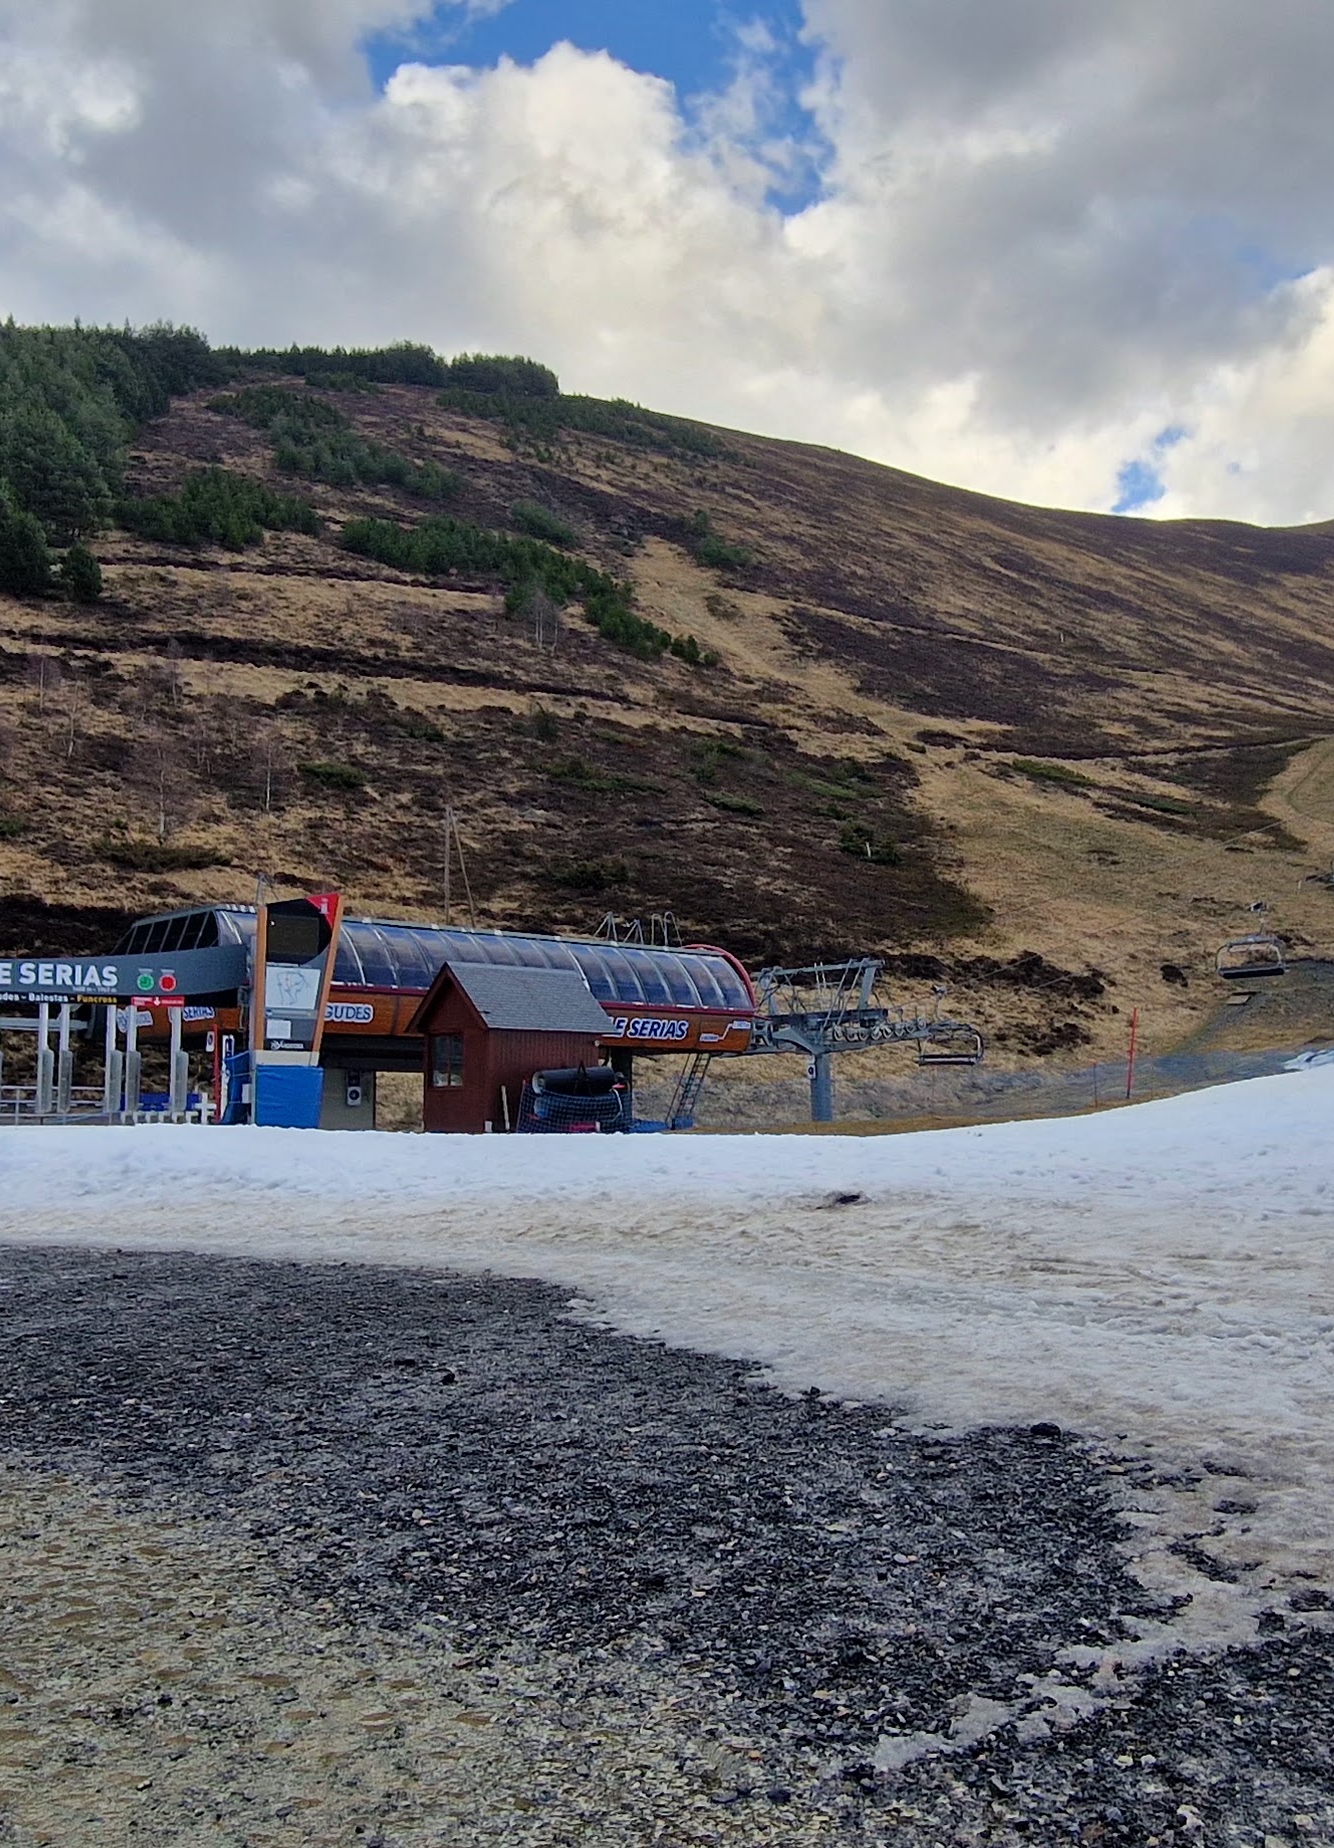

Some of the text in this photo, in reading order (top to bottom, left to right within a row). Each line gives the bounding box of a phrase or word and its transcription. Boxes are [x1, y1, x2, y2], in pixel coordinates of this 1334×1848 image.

[19, 962, 118, 987] SERIAS
[324, 1004, 372, 1020] GUDES
[628, 1019, 687, 1038] SERIAS
